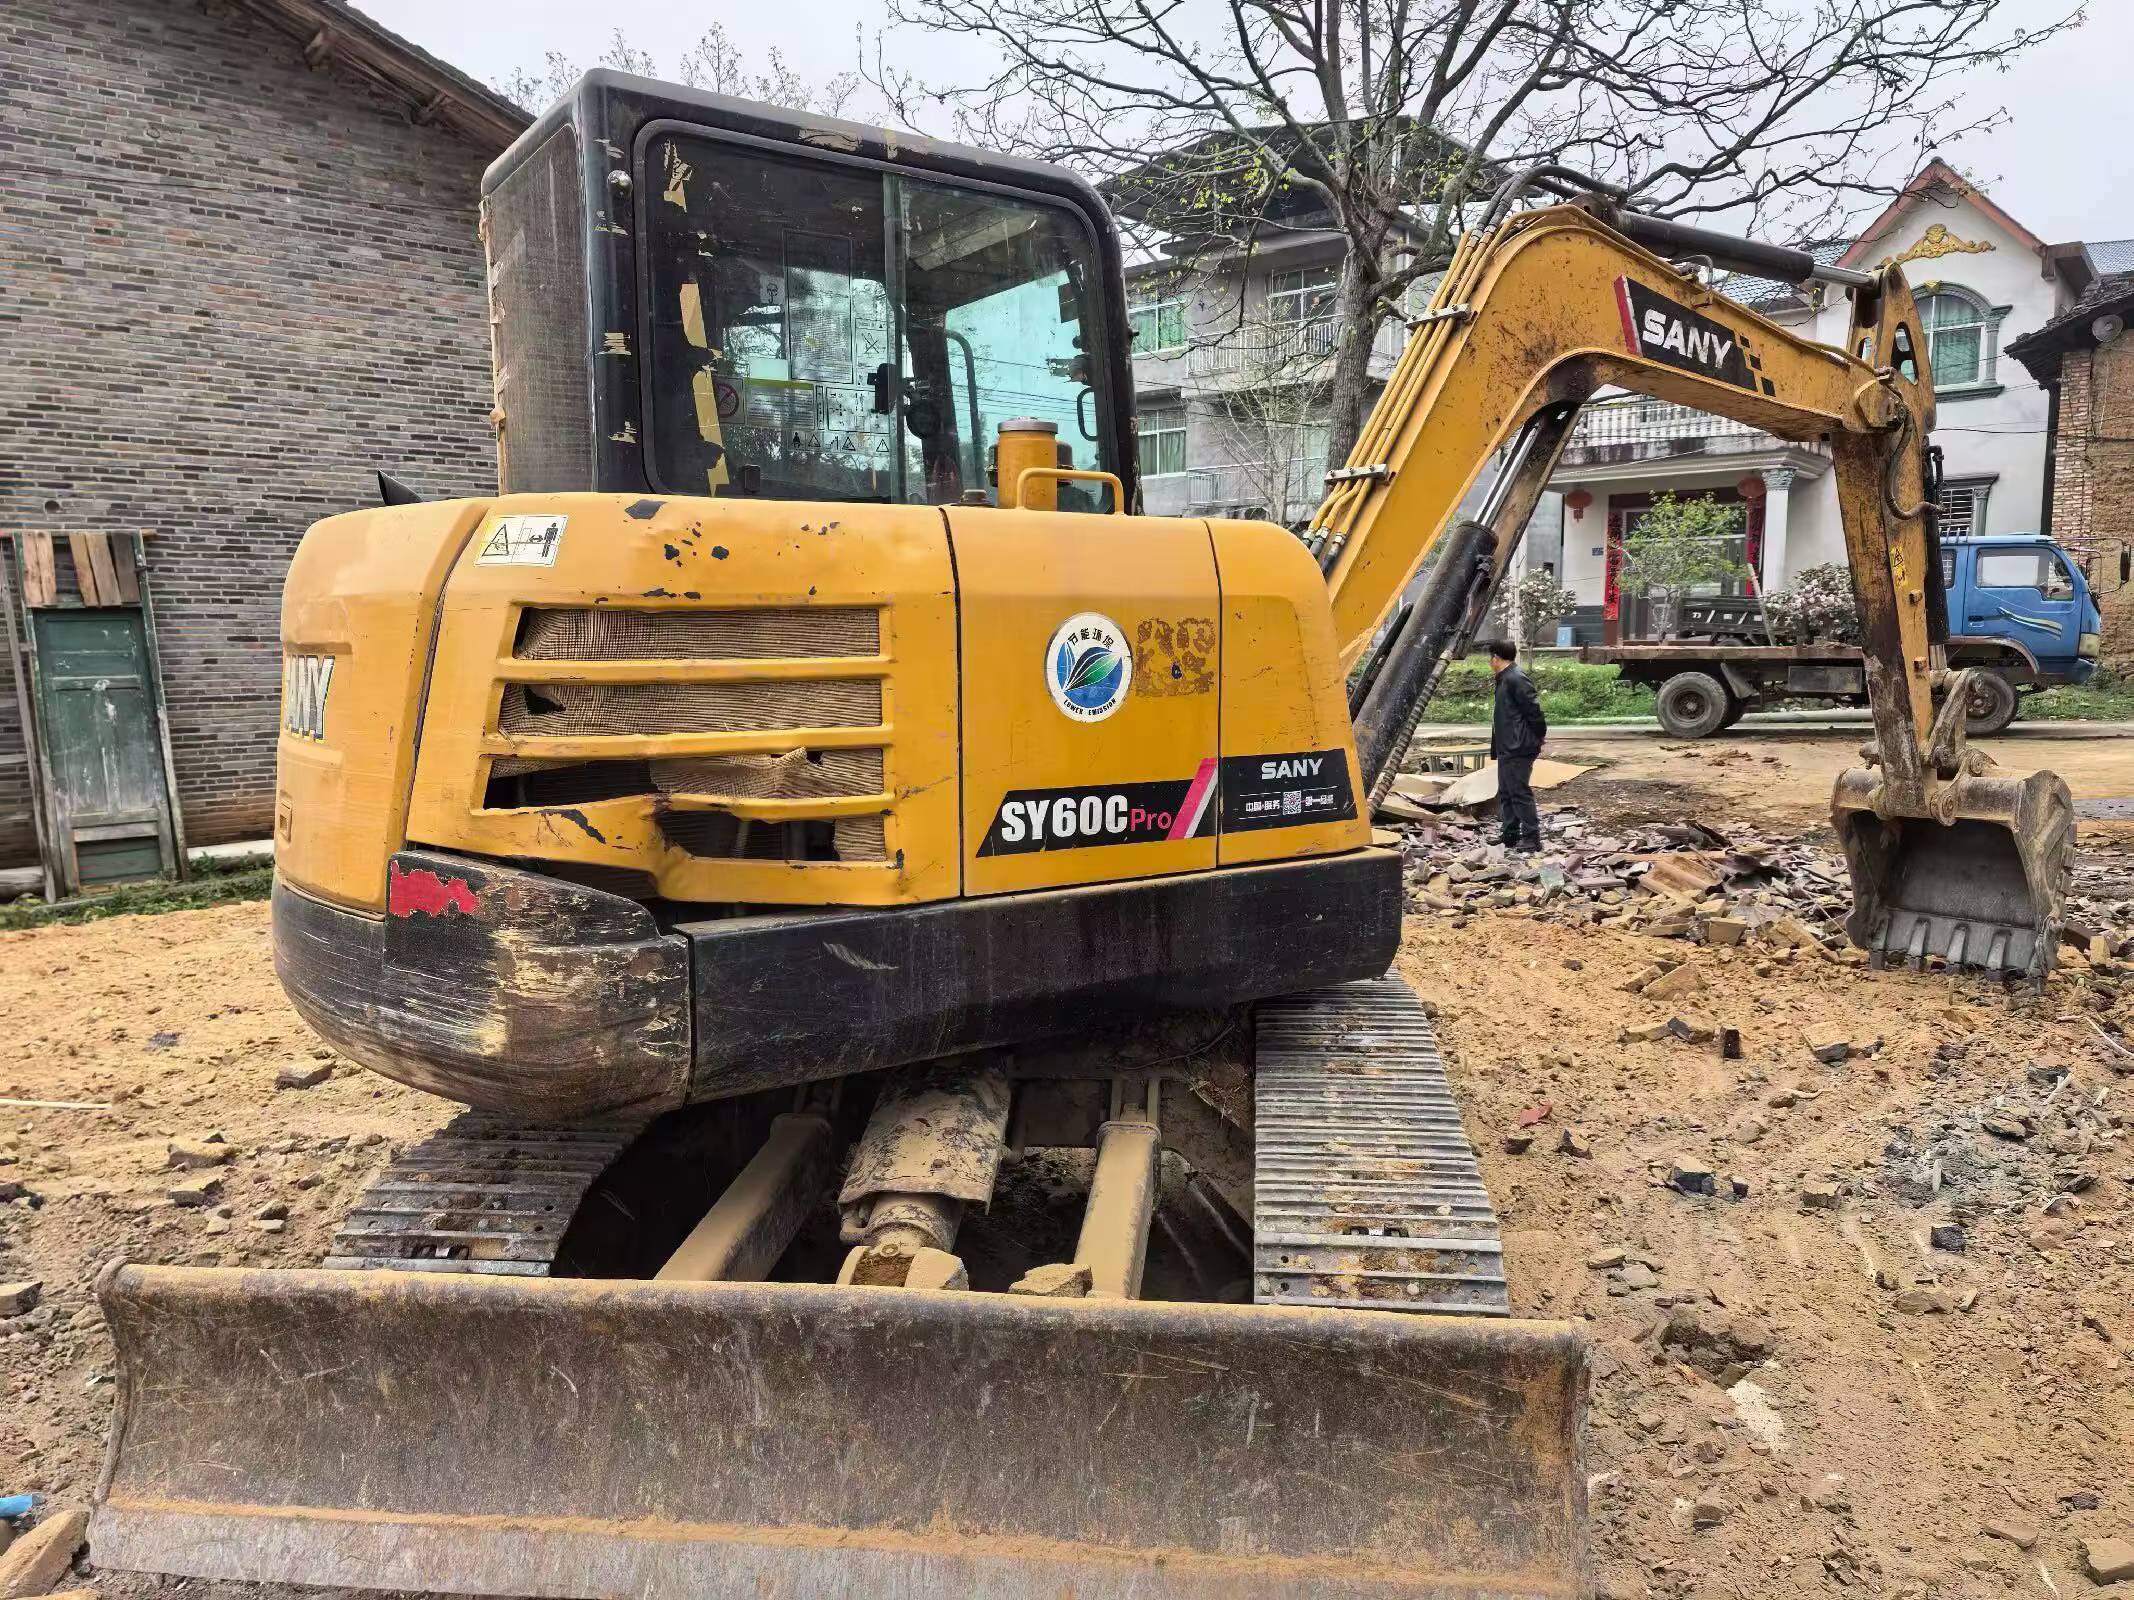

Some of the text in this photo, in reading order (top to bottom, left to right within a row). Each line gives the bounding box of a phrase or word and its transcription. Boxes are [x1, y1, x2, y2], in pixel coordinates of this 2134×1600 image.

[1642, 308, 1732, 369] SANY
[1067, 627, 1115, 650] 节能环保
[284, 654, 335, 739] ANY
[1063, 697, 1117, 716] LOWER EMISSION
[1261, 758, 1323, 780] SANY
